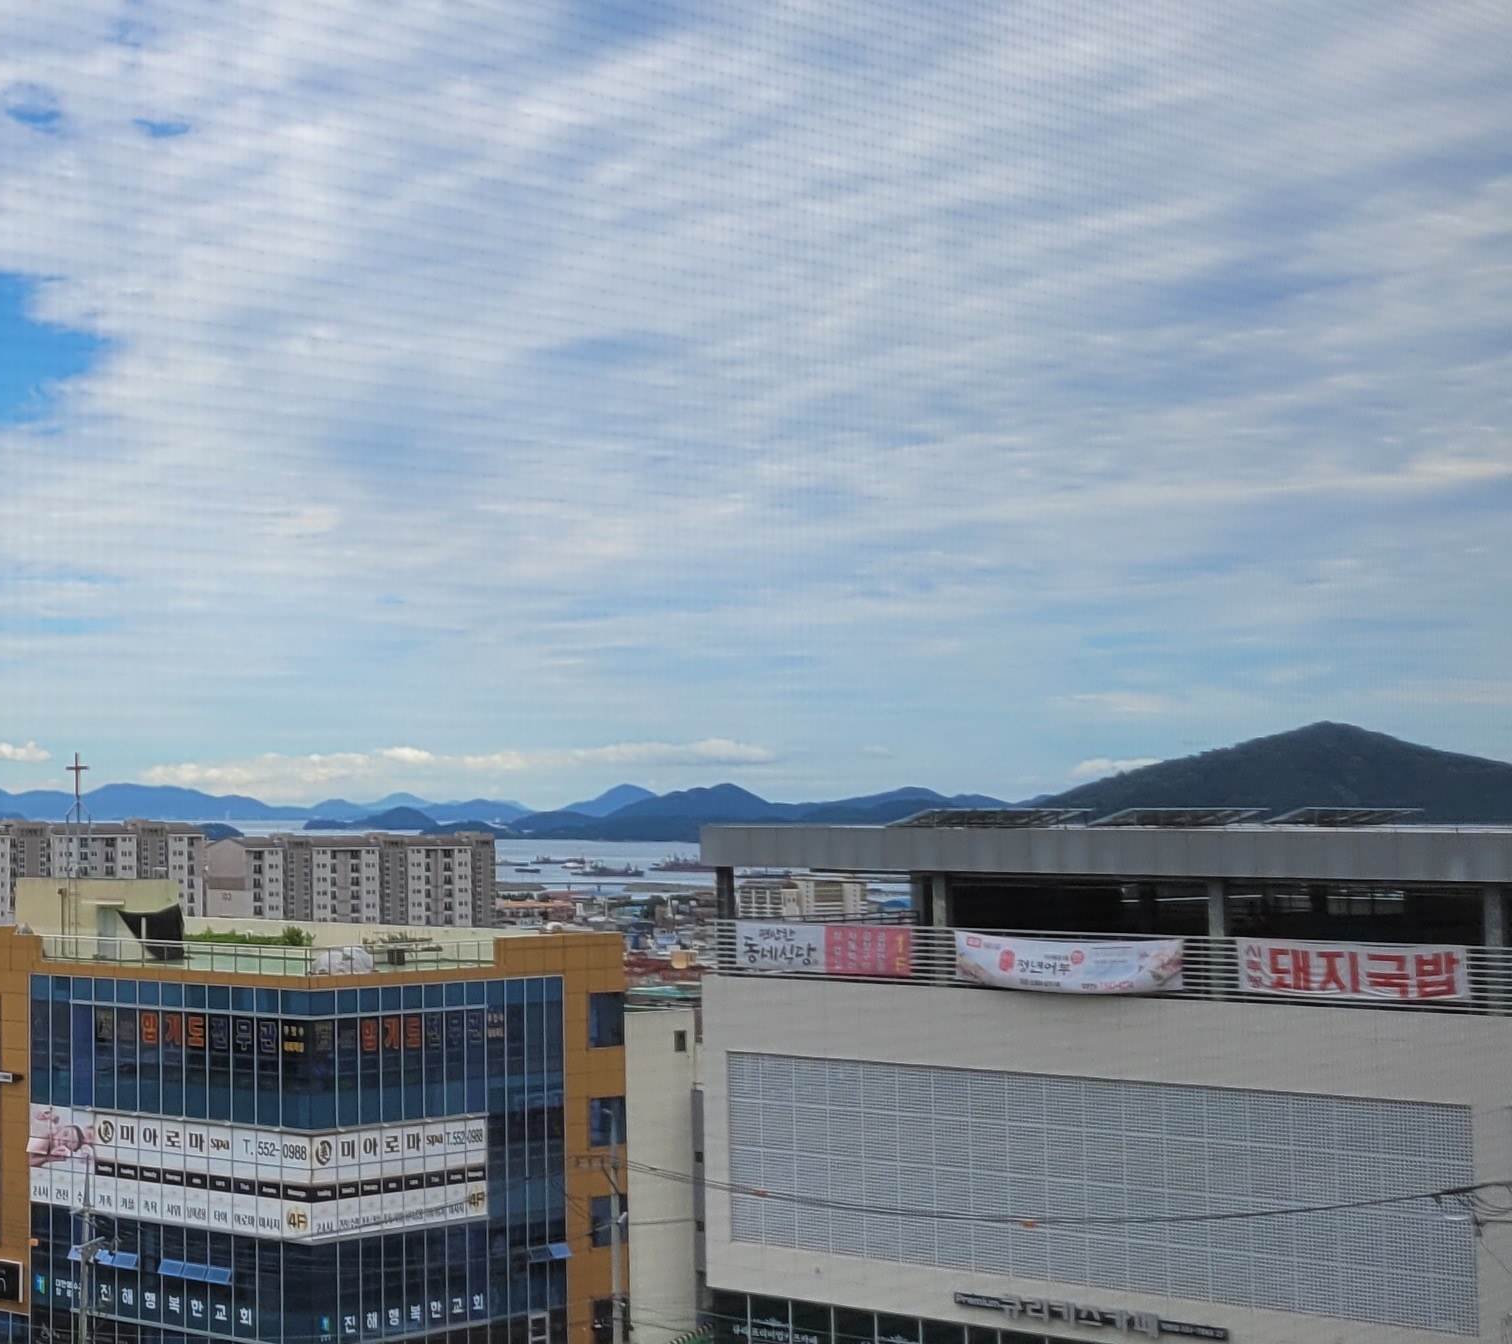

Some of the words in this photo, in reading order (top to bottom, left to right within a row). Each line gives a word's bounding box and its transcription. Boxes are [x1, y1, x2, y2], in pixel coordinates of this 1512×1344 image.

[743, 935, 817, 966] 동네식당
[1268, 947, 1460, 999] 돼지국밥
[141, 1012, 205, 1047] 합기도
[361, 1016, 421, 1052] 합기도
[119, 1123, 205, 1153] 미아로마
[210, 1137, 230, 1152] spa
[243, 1138, 254, 1156] T.
[257, 1141, 307, 1161] 552-0988
[340, 1132, 421, 1159] 미아로마
[426, 1133, 443, 1146] spa
[99, 1194, 112, 1207] 가족
[214, 1210, 228, 1223] 타이
[234, 1213, 255, 1226] 아로마
[259, 1216, 280, 1230] 마사지
[288, 1212, 307, 1229] 4F
[470, 1191, 485, 1207] 4F
[100, 1283, 253, 1327] 진해행복한교회
[344, 1292, 484, 1334] 진해행복한교회
